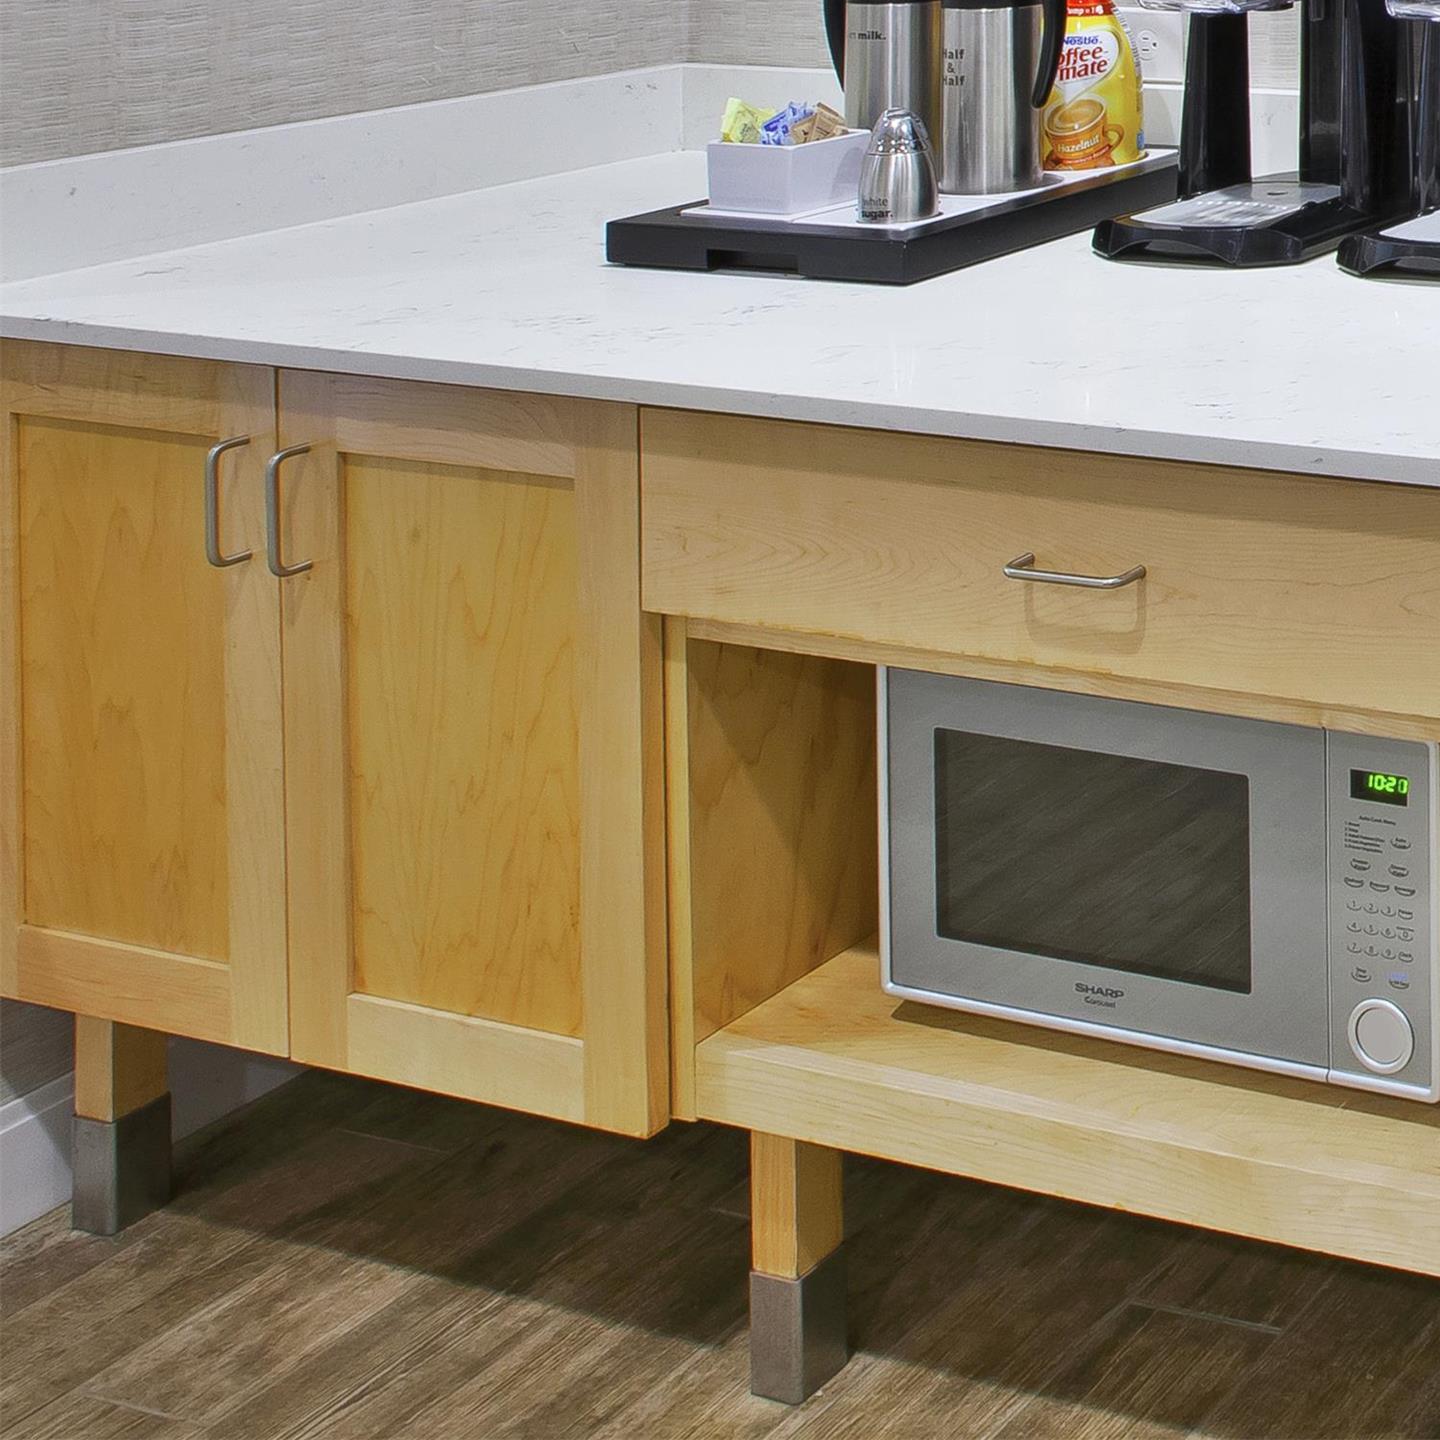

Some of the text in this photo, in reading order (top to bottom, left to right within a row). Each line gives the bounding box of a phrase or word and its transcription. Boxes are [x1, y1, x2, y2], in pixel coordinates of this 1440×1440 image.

[858, 30, 887, 40] milk.
[946, 62, 956, 74] &
[1059, 59, 1109, 81] mate
[1057, 134, 1100, 153] Hazelnut
[1075, 982, 1124, 998] SHARP
